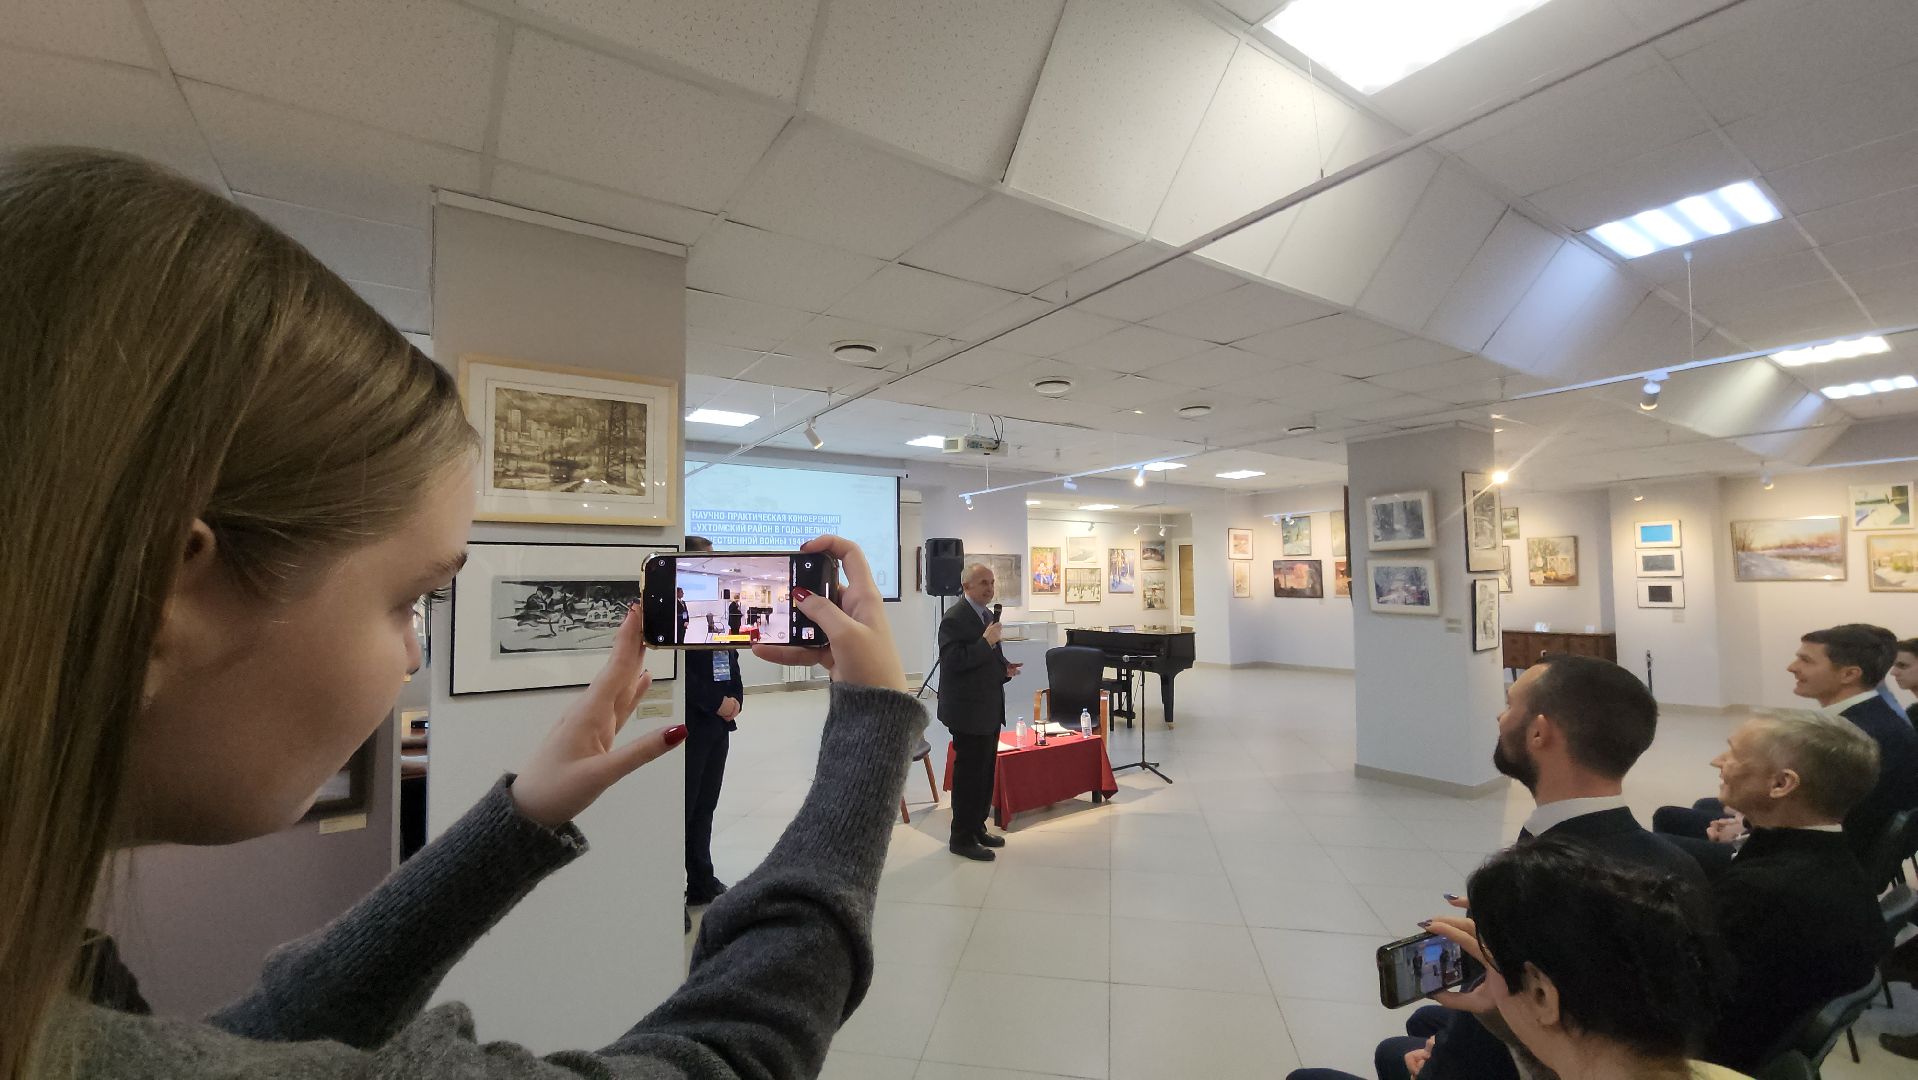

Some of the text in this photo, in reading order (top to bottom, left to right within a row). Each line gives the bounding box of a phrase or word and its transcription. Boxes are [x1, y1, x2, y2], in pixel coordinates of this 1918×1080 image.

[788, 514, 840, 524] КОНФЕРЕНЦИЯ
[747, 522, 773, 533] РАЙОН
[774, 525, 780, 534] В
[781, 525, 804, 535] ГОДЫ
[759, 535, 787, 545] ВОЙНЫ
